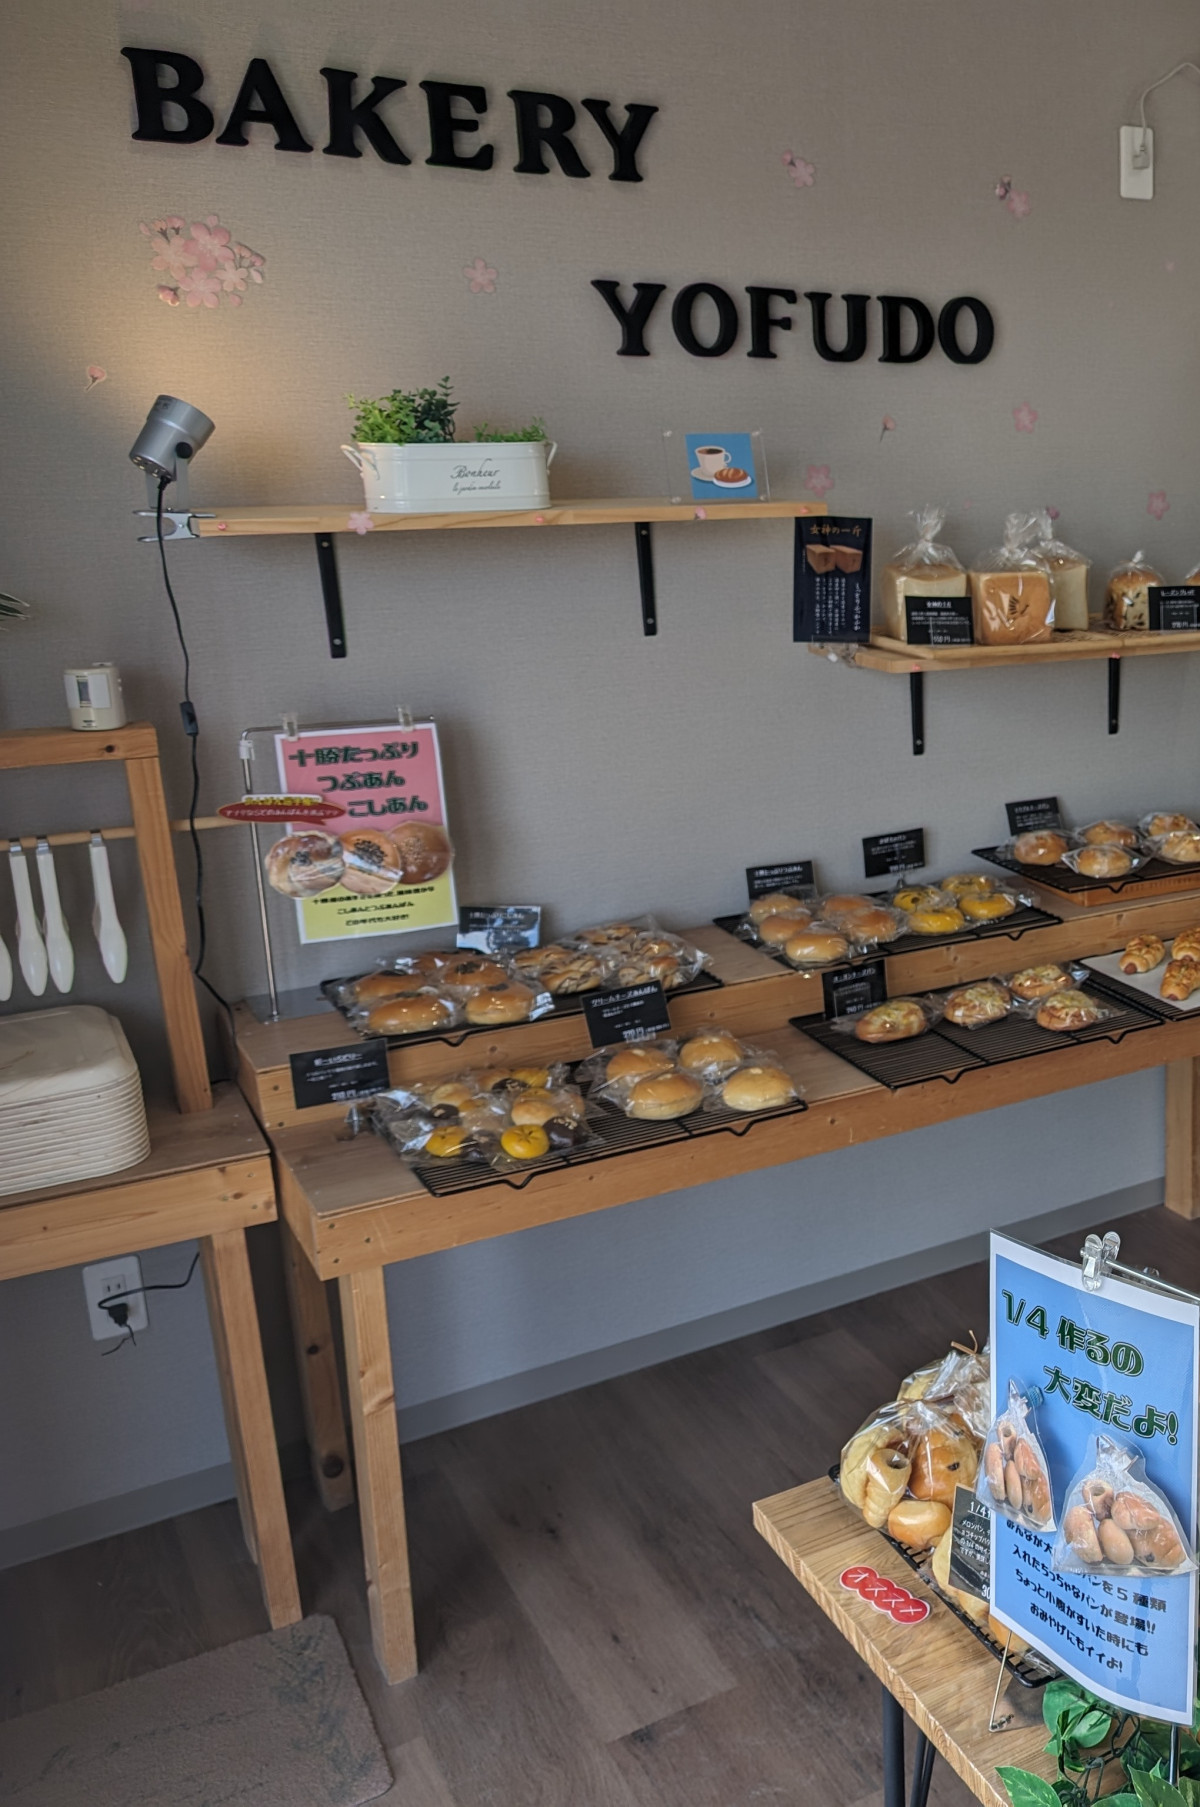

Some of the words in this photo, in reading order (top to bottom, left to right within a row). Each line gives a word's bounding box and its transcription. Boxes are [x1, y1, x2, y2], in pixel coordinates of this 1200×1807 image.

[120, 47, 659, 182] BAKERY
[590, 279, 994, 364] YOFUDO
[288, 741, 419, 767] 十勝たっぷり
[317, 770, 406, 792] つぶあん
[347, 795, 429, 817] こしあん
[1043, 1365, 1179, 1446] 大変だよ!
